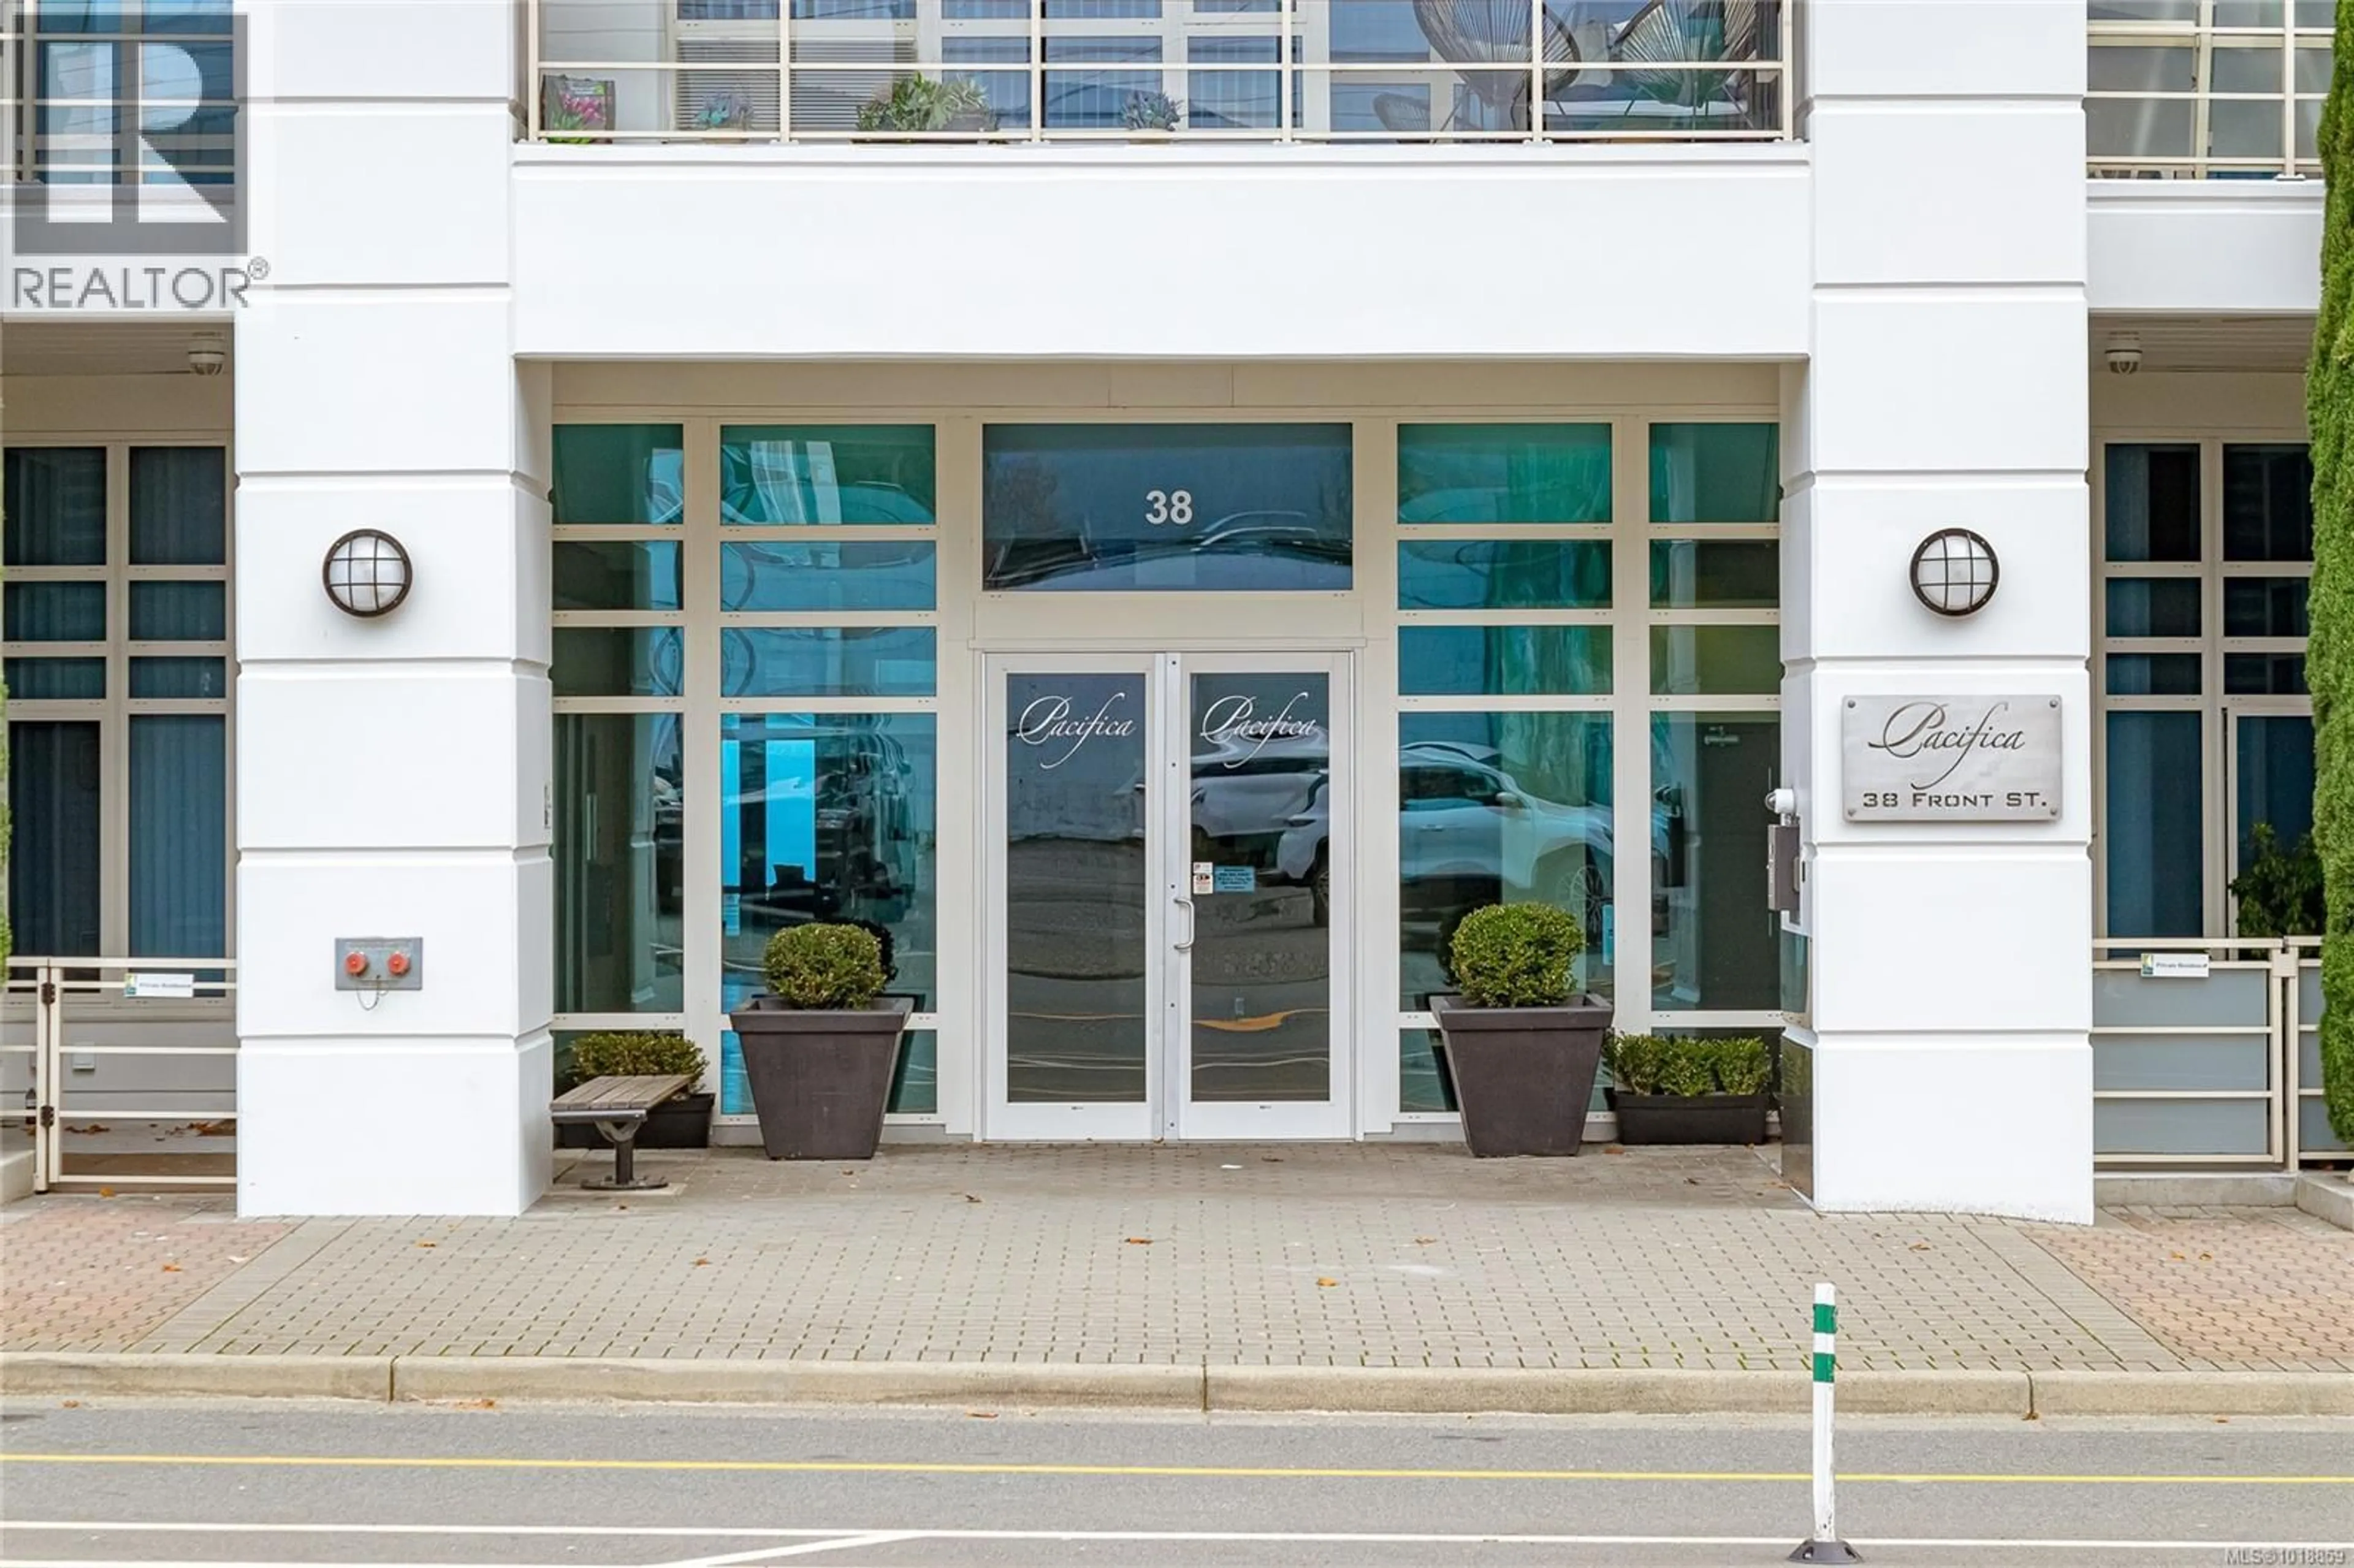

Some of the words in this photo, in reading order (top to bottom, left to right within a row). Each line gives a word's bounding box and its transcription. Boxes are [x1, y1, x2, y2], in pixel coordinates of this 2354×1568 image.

[1145, 490, 1192, 525] 38
[1016, 692, 1136, 769] Pacifica
[1200, 691, 1319, 769] Pacifica
[1868, 701, 2026, 790] Pacifica
[1862, 793, 1899, 807] 38
[1912, 793, 1994, 808] FRONT
[2006, 793, 2047, 808] ST.
